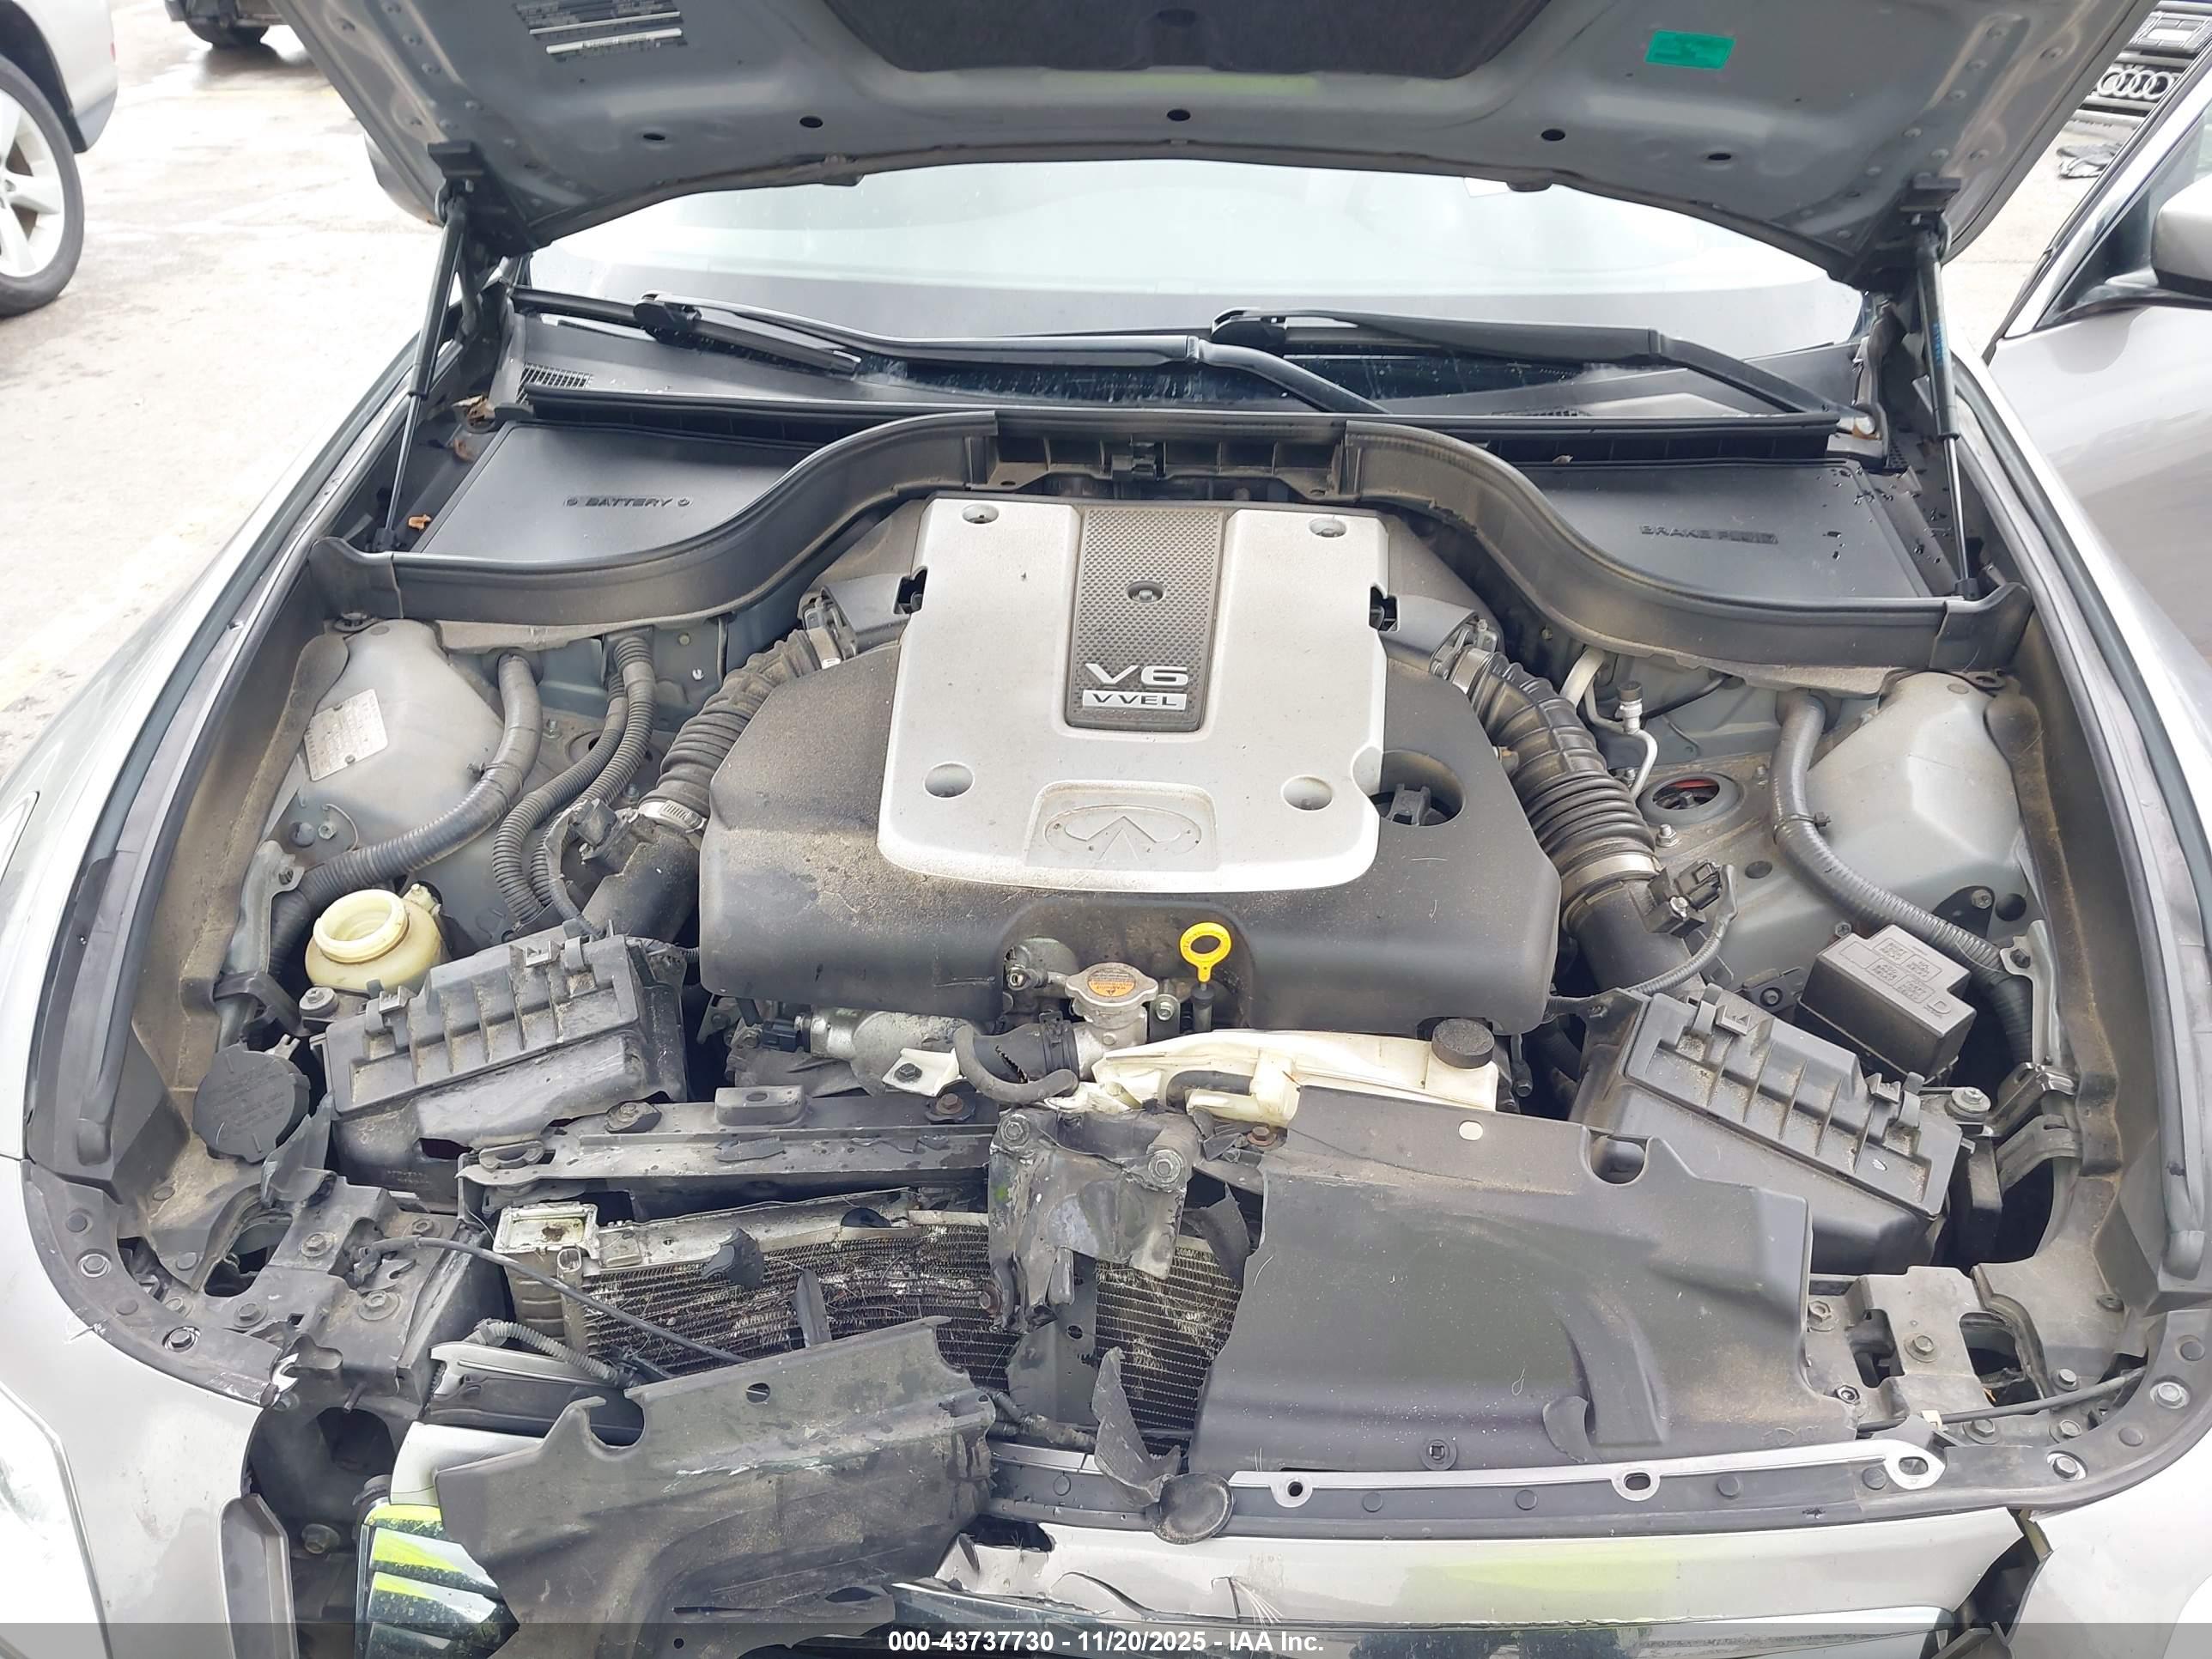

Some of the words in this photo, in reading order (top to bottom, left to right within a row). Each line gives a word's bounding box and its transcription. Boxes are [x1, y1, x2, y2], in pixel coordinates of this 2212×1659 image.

[585, 496, 674, 507] BATTERY
[1085, 663, 1189, 687] V6
[1091, 692, 1177, 707] VVEL
